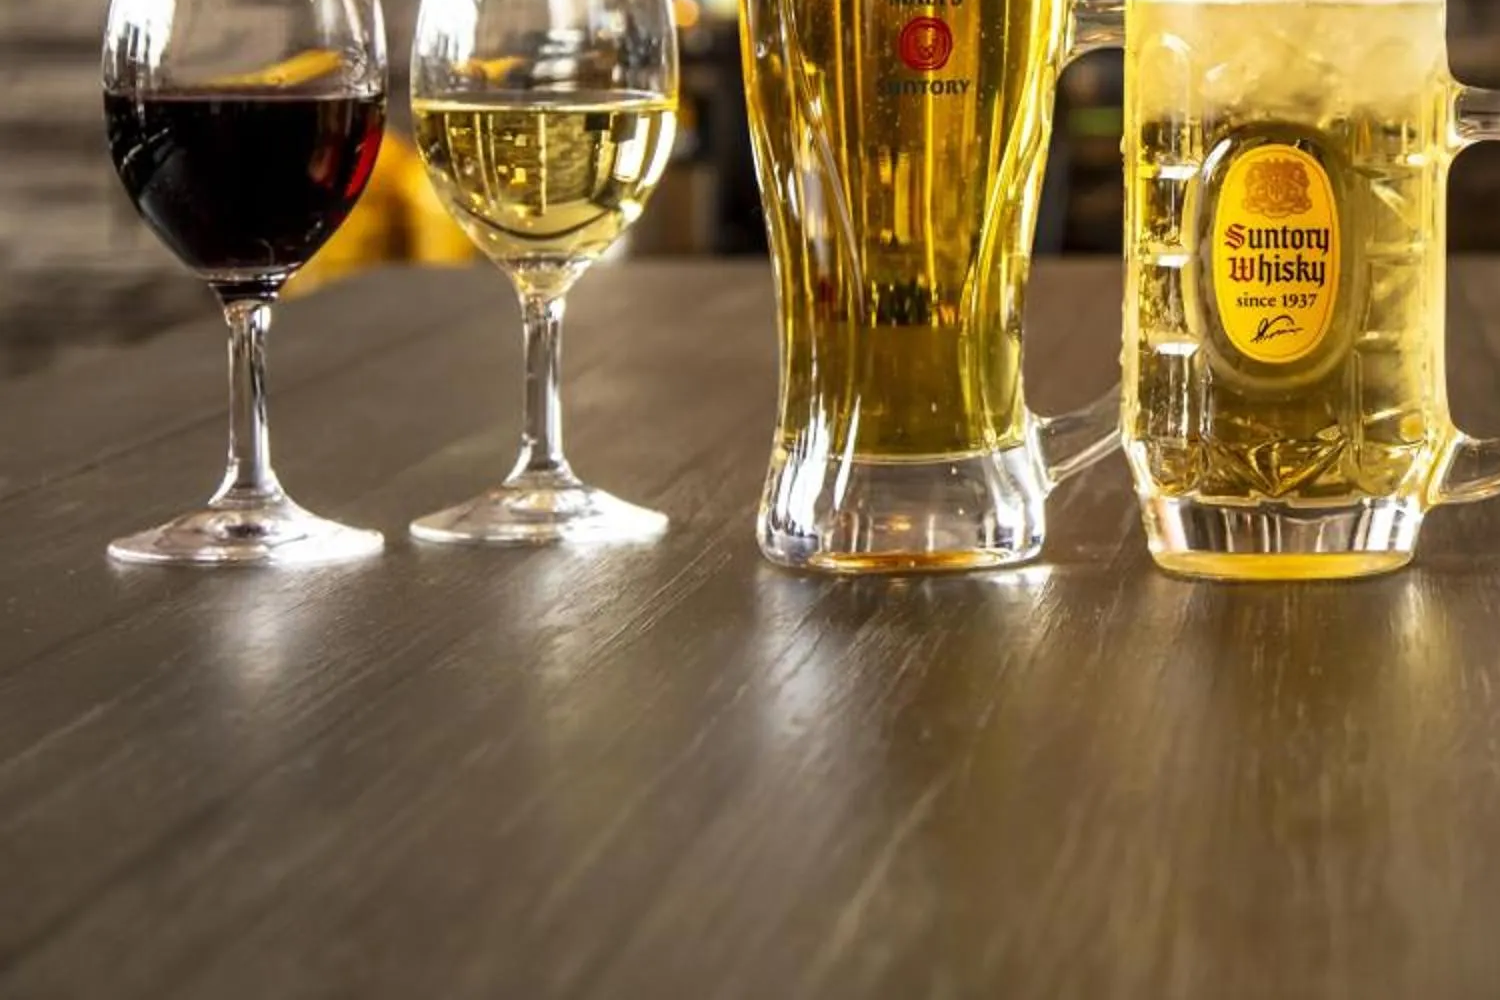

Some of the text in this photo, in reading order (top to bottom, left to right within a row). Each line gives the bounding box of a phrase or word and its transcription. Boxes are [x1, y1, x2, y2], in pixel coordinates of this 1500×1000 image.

[1225, 223, 1329, 254] Suntory
[1227, 253, 1326, 288] Whisky
[1236, 293, 1318, 308] since 1937
